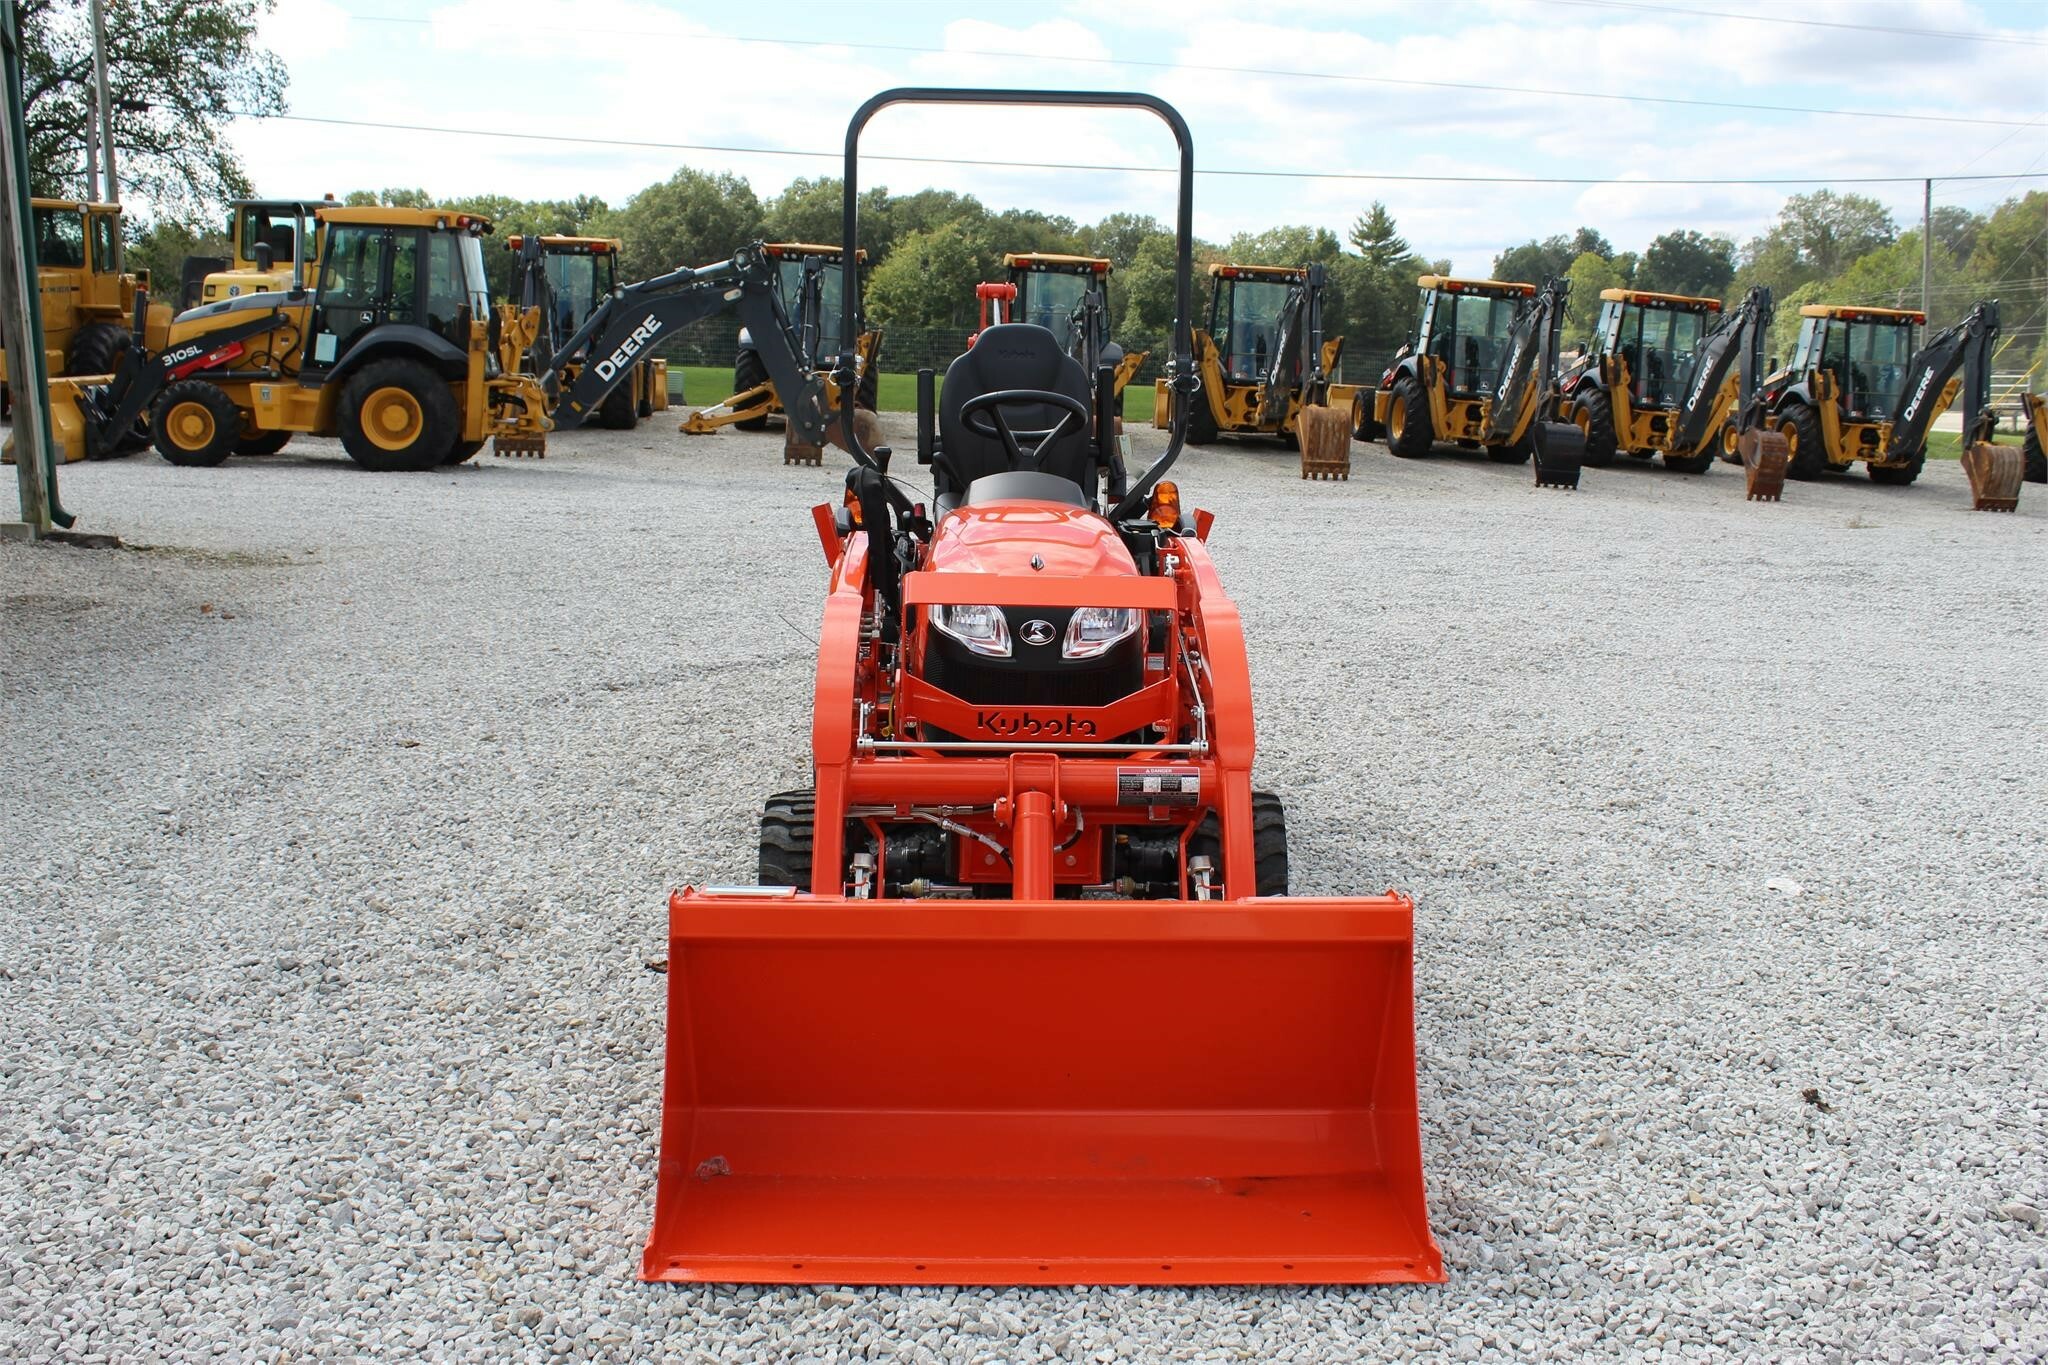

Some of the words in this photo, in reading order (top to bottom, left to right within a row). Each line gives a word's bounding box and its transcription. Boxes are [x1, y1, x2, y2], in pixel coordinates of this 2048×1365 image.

[162, 345, 203, 366] 310SL
[594, 313, 663, 382] DEERE
[1270, 329, 1287, 385] DEERE
[1498, 344, 1521, 401] DEERE
[1687, 355, 1714, 412] DEERE
[1903, 366, 1935, 422] DEERE
[977, 711, 1097, 737] Kubota
